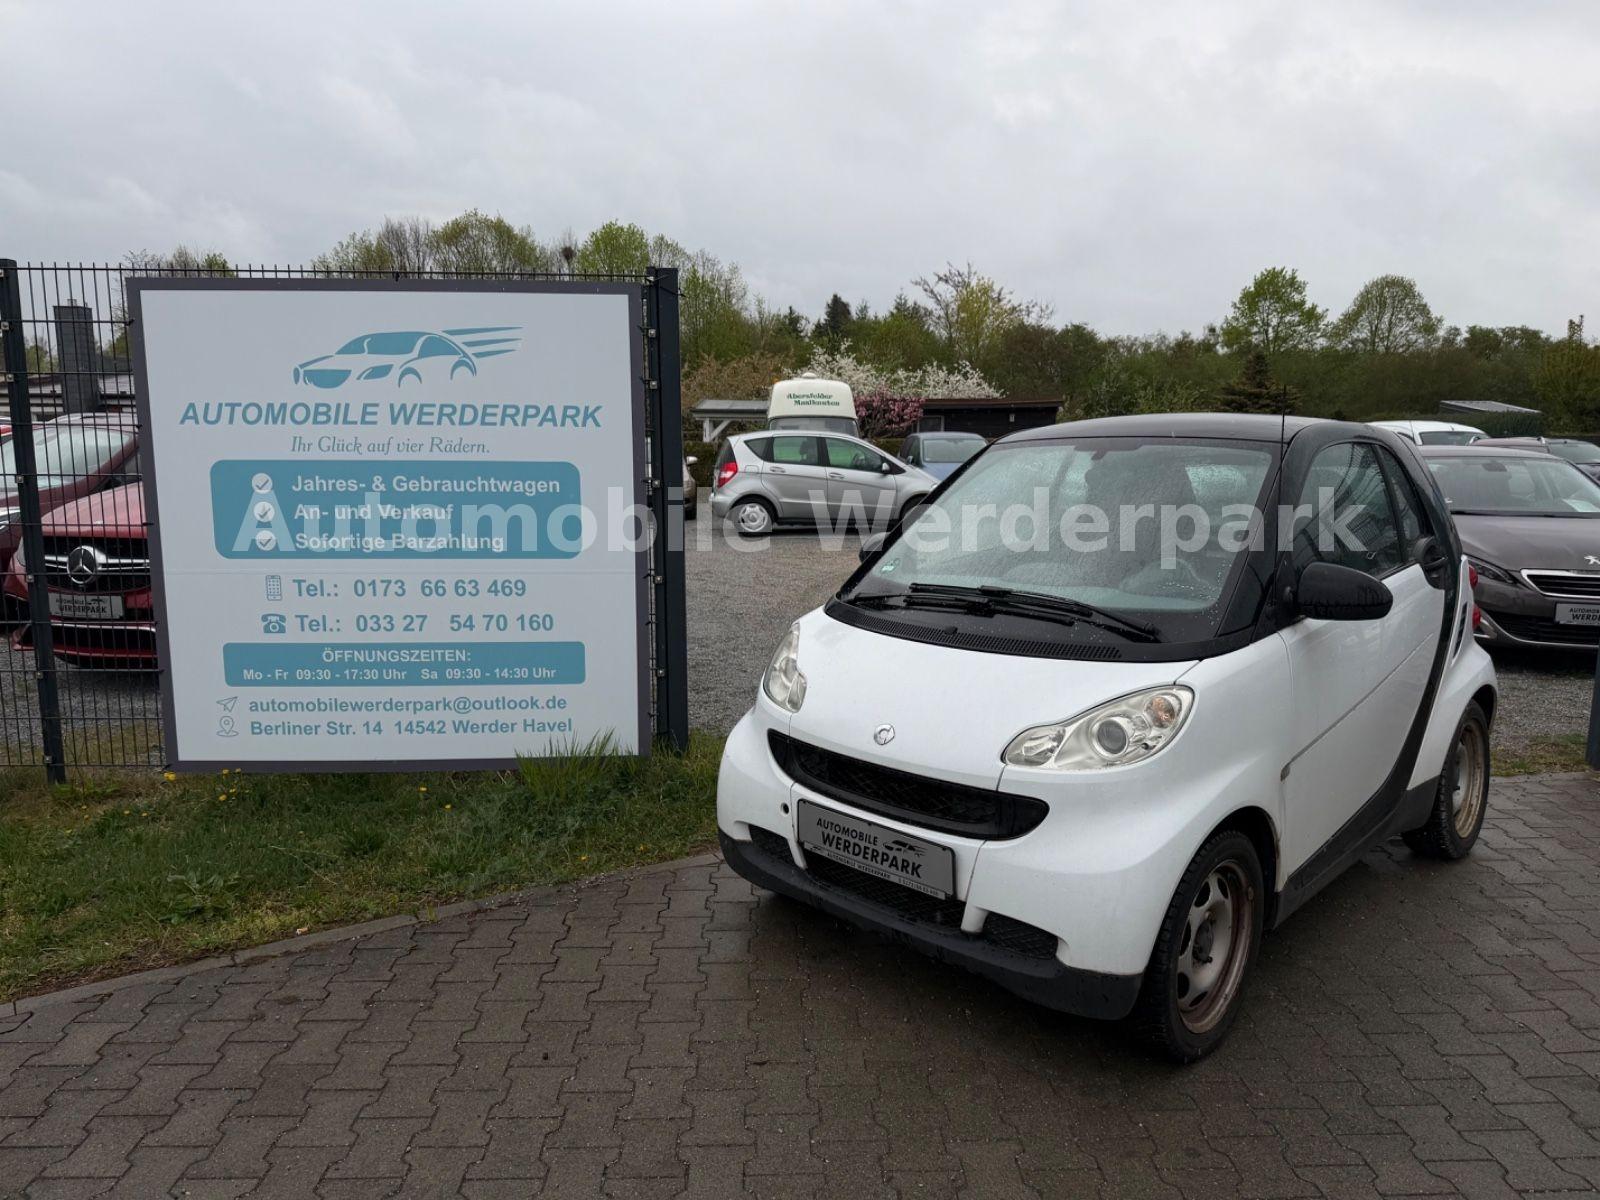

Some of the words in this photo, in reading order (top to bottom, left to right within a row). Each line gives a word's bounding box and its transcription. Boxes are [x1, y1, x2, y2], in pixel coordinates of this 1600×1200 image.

[179, 402, 380, 427] AUTOMOBILE
[388, 403, 603, 428] WERDERPARK
[290, 436, 314, 453] Ihr
[317, 436, 363, 456] Glück
[366, 436, 395, 456] auf
[396, 437, 424, 455] vier
[429, 437, 491, 455] Rädern.
[291, 475, 366, 494] Jahres-
[371, 476, 386, 492] &
[392, 476, 561, 497] Gebrauchtwagen
[294, 505, 329, 521] An-
[334, 505, 372, 521] und
[376, 504, 454, 521] Verkauf
[295, 533, 385, 553] Sofortige
[391, 533, 504, 554] Barzahlung
[292, 579, 339, 598] Tel.:
[353, 579, 406, 598] 0173
[420, 579, 447, 597] 66
[453, 579, 480, 597] 63
[486, 579, 527, 597] 469
[295, 614, 341, 633] Tel.:
[355, 614, 395, 633] 033
[402, 614, 428, 632] 27
[449, 614, 476, 632] 54
[482, 614, 508, 632] 70
[515, 614, 554, 632] 160
[322, 647, 471, 663] ÖFFNUNGSZEITEN:
[243, 669, 263, 681] Mo
[275, 669, 289, 681] Fr
[296, 669, 332, 681] 09:30
[343, 669, 379, 681] 17:30
[383, 669, 407, 681] Uhr
[420, 668, 438, 680] Sa
[446, 668, 481, 680] 09:30
[494, 668, 529, 680] 14:30
[533, 667, 556, 679] Uhr
[249, 696, 567, 715] automobilewerderpark@outlook.de
[250, 720, 322, 736] Berliner
[326, 720, 356, 736] Str.
[363, 720, 382, 735] 14
[394, 719, 446, 735] 14542
[452, 719, 519, 734] Werder
[523, 718, 572, 733] Havel
[816, 818, 878, 846] AUTOMOBILE
[821, 831, 923, 879] WERDERPARK
